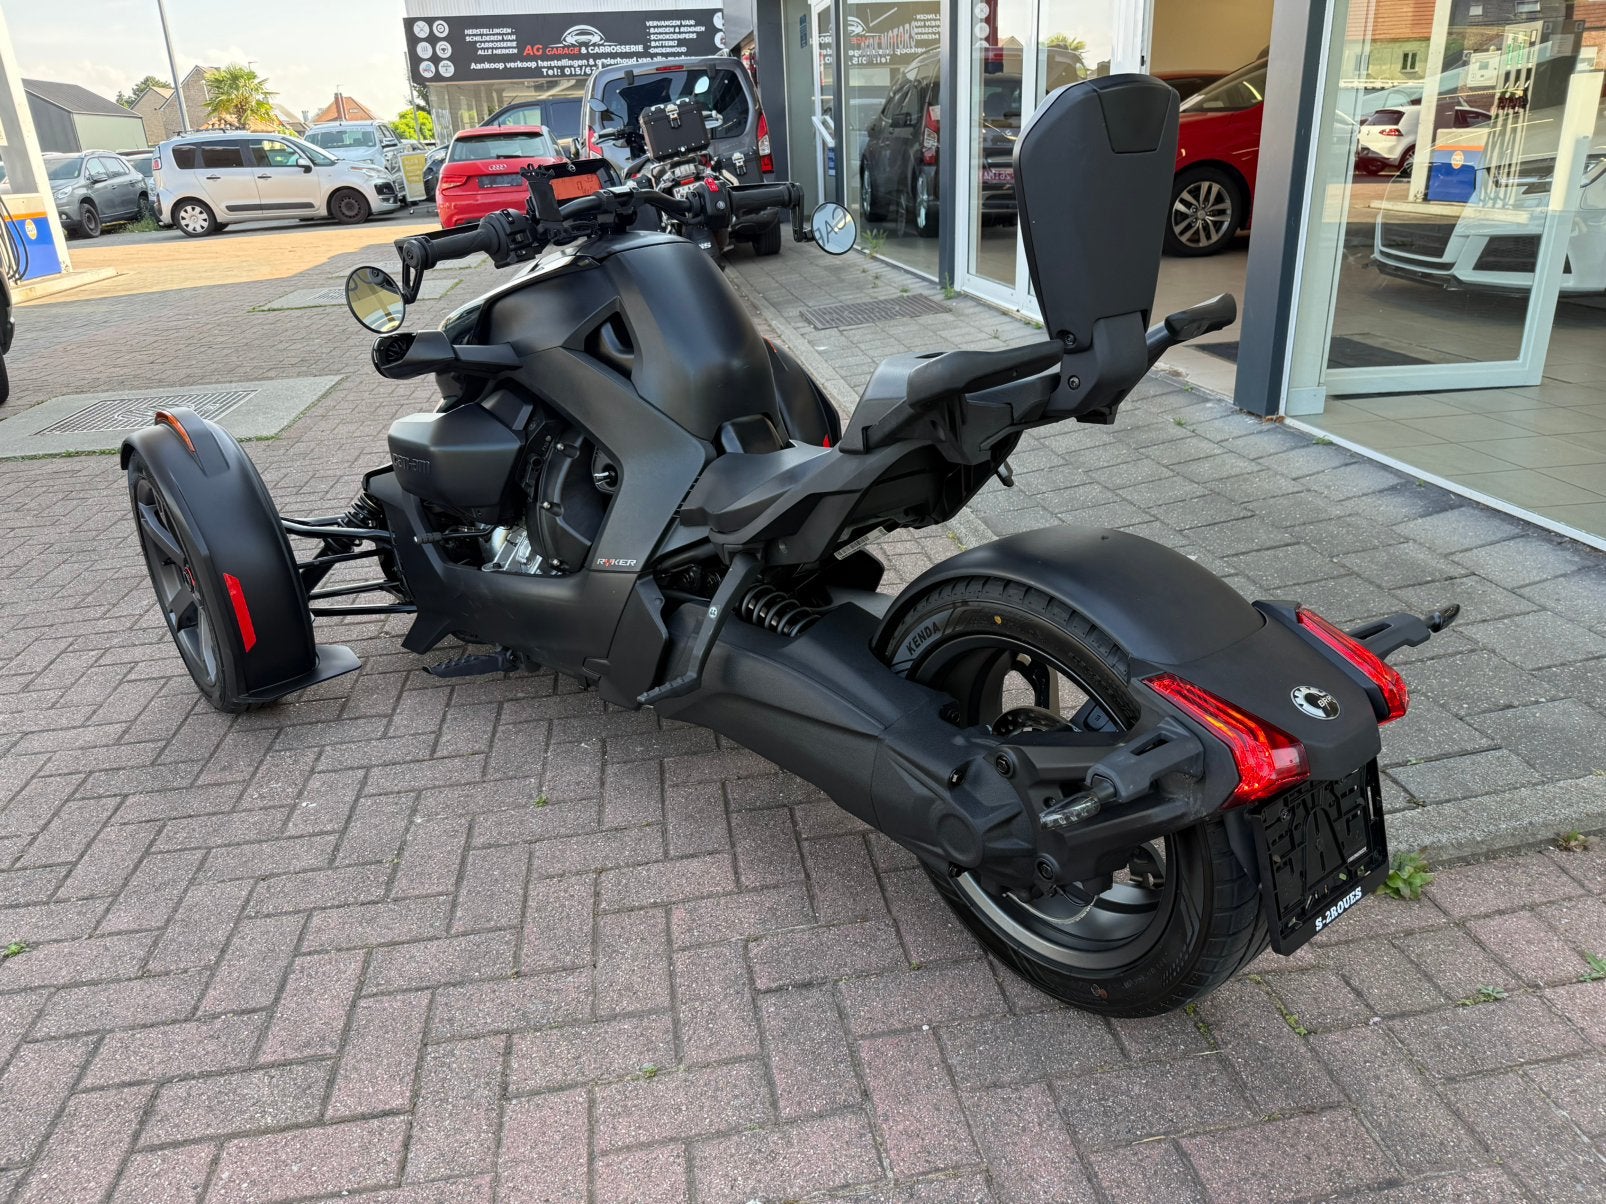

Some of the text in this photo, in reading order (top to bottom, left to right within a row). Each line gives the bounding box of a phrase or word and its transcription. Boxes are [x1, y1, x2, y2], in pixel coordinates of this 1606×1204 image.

[523, 45, 543, 56] AG
[588, 45, 643, 53] CARROSSERIE
[470, 62, 504, 70] Aankoop
[506, 61, 537, 69] verkoop
[538, 59, 587, 67] herstellingen
[542, 68, 561, 76] Tel:
[597, 558, 637, 567] RYKER
[906, 621, 941, 656] KENDA
[1315, 887, 1362, 931] S-2ROUES
